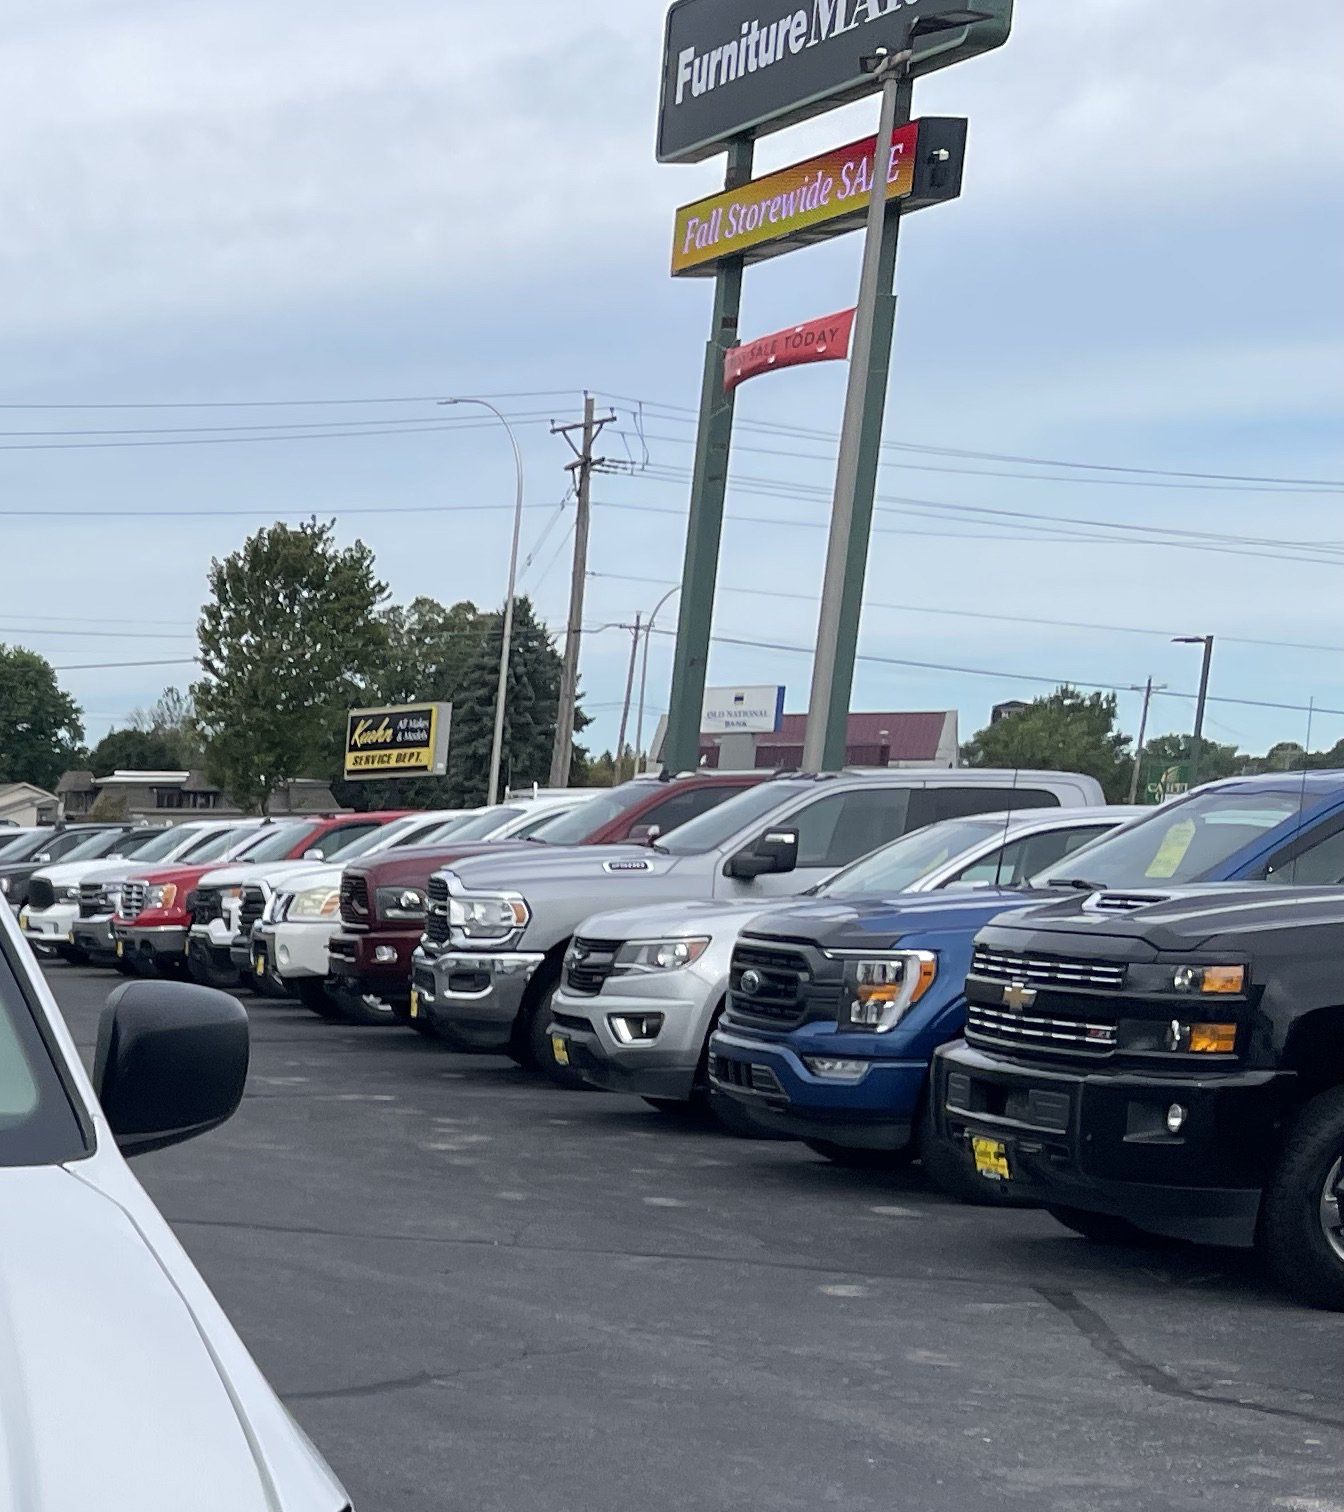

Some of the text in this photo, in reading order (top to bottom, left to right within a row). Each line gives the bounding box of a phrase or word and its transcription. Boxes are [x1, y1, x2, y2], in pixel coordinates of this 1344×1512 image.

[675, 0, 918, 105] FurnitureMA
[682, 143, 904, 255] Fall Storewide SAE
[785, 327, 840, 350] TODAY
[727, 710, 768, 719] NATIONAL
[352, 753, 392, 766] SERVICE
